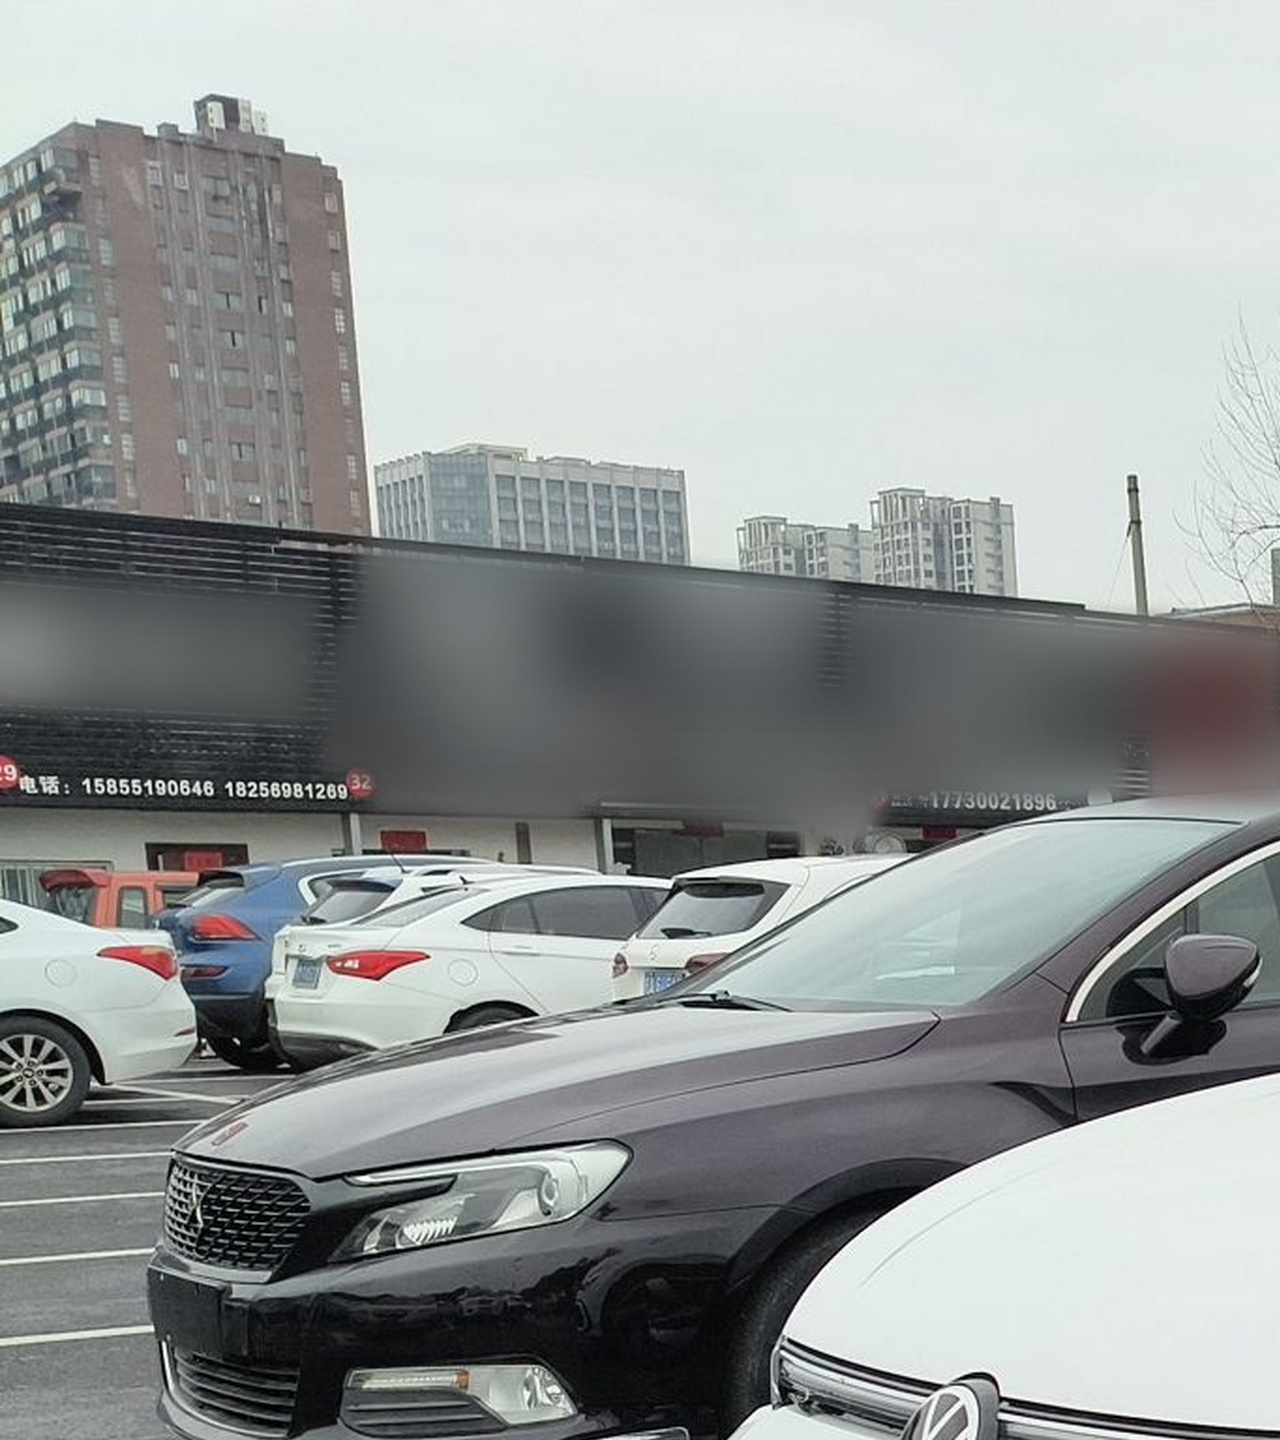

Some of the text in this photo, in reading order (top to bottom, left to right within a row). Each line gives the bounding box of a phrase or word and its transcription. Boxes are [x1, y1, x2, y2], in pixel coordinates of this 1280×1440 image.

[82, 777, 214, 797] 15855190646
[224, 781, 348, 800] 18256981269
[351, 774, 372, 790] 32
[929, 791, 1057, 811] 17730021896
